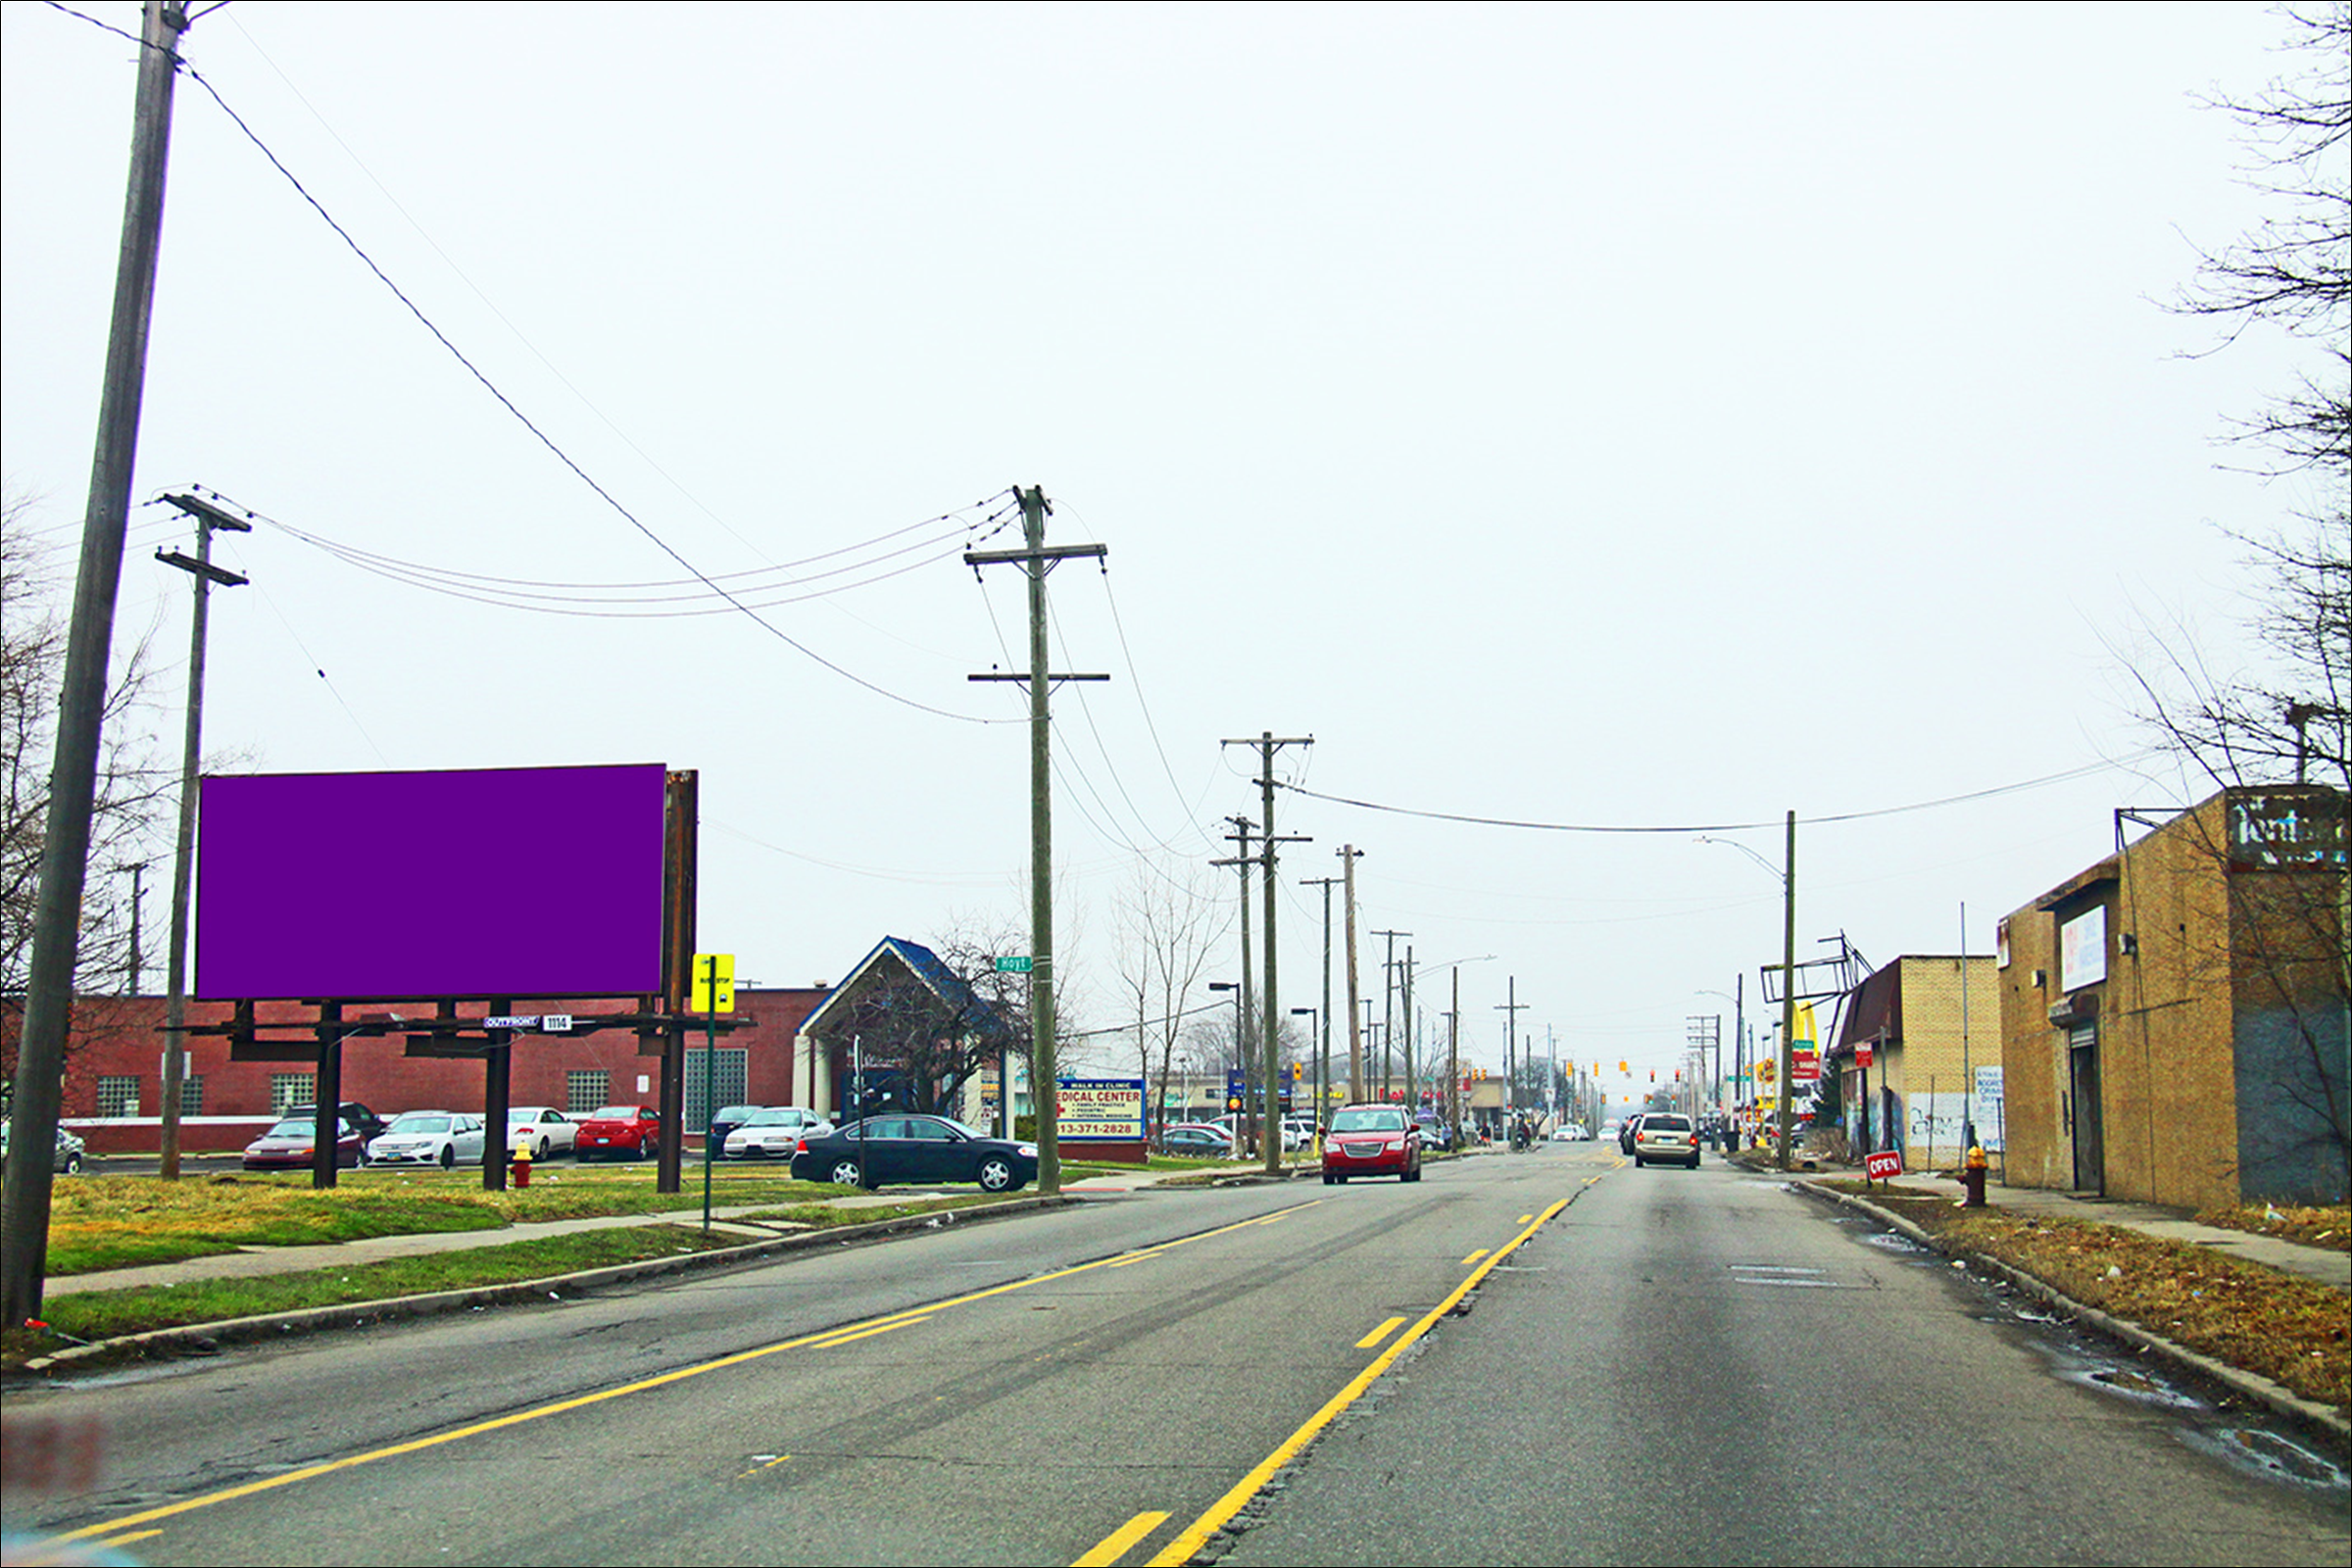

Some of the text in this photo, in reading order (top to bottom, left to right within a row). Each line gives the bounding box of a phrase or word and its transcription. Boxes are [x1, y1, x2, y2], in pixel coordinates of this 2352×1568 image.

[1001, 957, 1026, 970] Hoyt
[548, 1017, 567, 1028] 1114
[1055, 1091, 1141, 1102] EDICAL CENTER
[1870, 1157, 1897, 1174] OPEN
